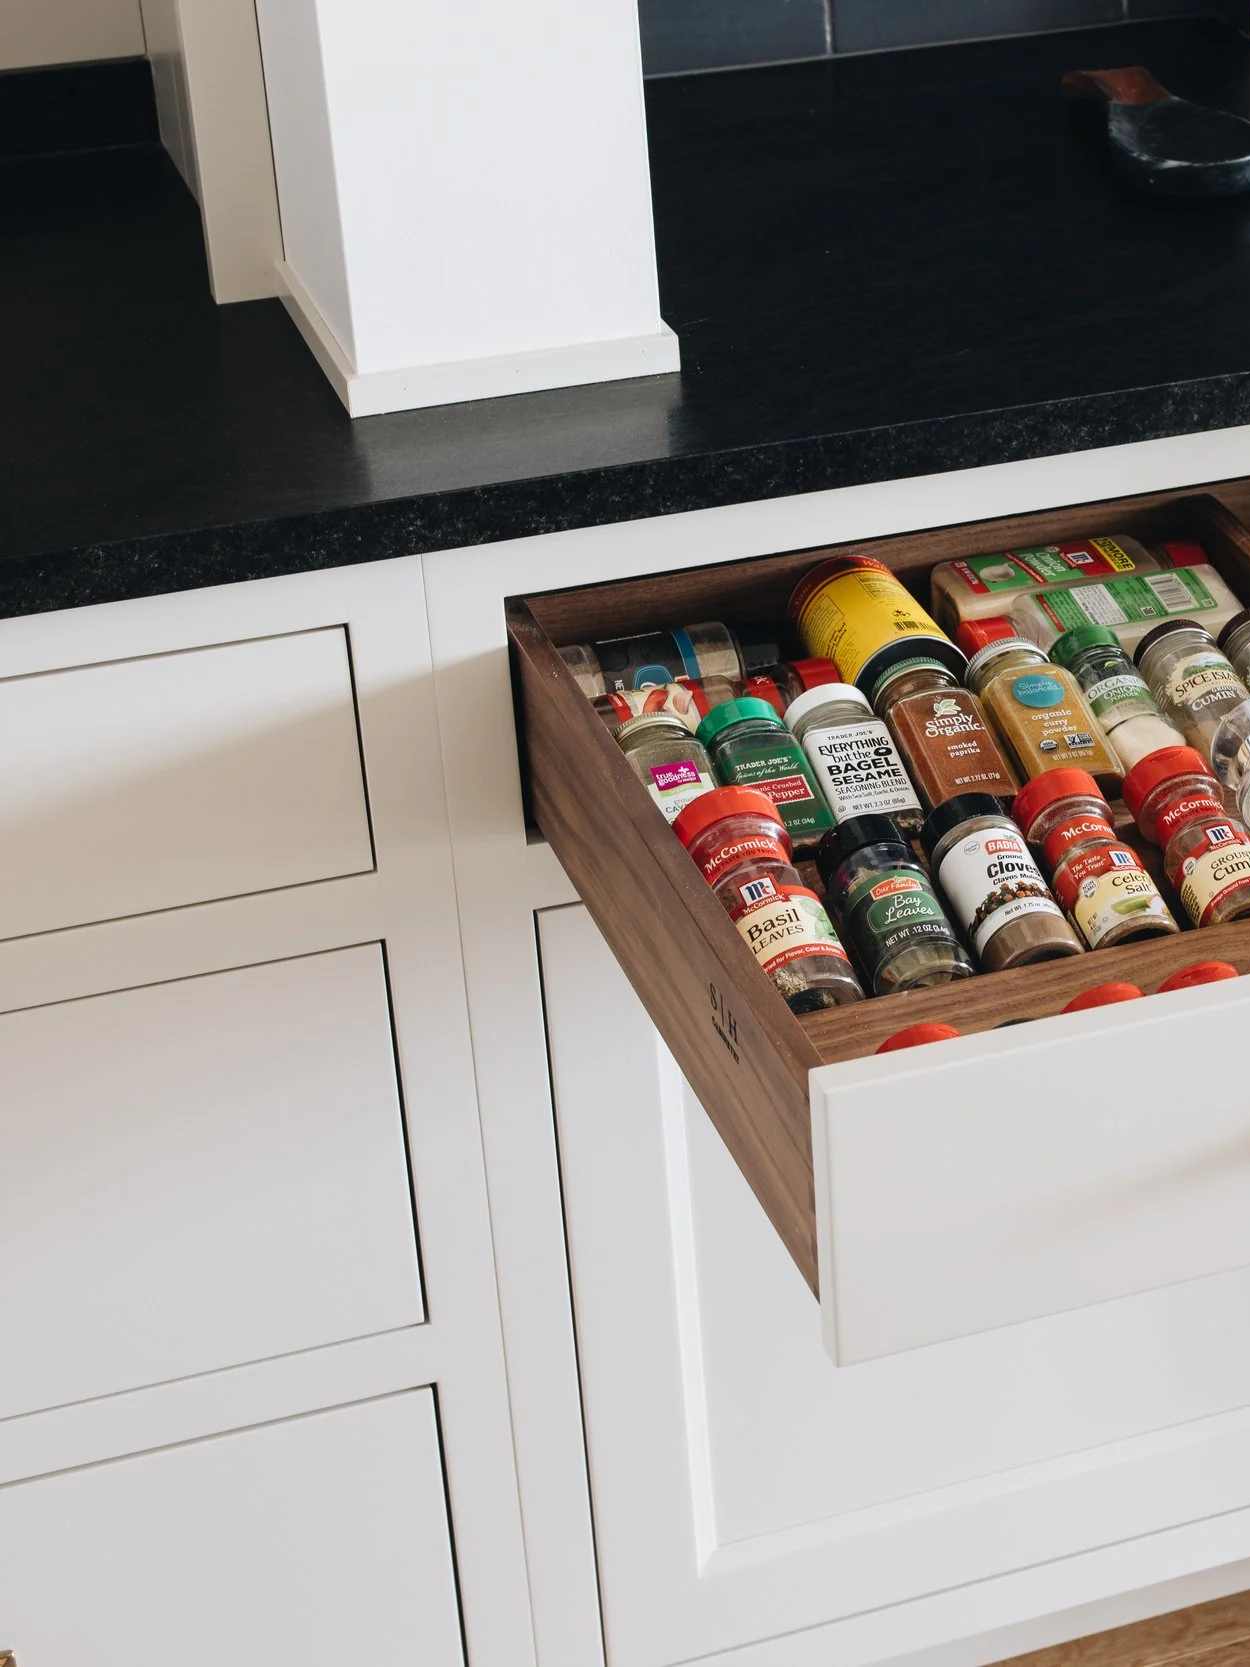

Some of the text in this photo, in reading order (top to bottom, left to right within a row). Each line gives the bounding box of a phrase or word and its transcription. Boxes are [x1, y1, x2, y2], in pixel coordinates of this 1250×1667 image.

[1019, 553, 1057, 577] Powder
[1036, 551, 1066, 572] Onion
[1019, 679, 1054, 690] Simply
[1087, 675, 1146, 699] ORGANIC
[1103, 685, 1140, 699] ONION
[1175, 674, 1211, 698] SPICE
[1191, 690, 1236, 711] CUMIN
[1031, 708, 1073, 720] organic
[925, 713, 973, 731] Simply
[1044, 719, 1068, 728] curry
[854, 730, 873, 738] JOE'S
[1042, 725, 1077, 736] powder
[818, 736, 889, 756] EVERYTHING
[947, 740, 977, 751] smoked
[949, 747, 980, 758] paprika
[735, 756, 789, 771] TRADER JOE'S
[832, 750, 872, 763] but the
[778, 762, 800, 772] World
[827, 756, 898, 776] BAGEL
[655, 772, 673, 780] true
[657, 771, 696, 787] goodness
[831, 768, 903, 787] SESAME
[772, 780, 802, 790] Crushed
[835, 778, 907, 796] SEASONING BLEND
[767, 787, 805, 800] Pepper
[988, 840, 1020, 851] BADIA
[704, 838, 778, 874] McCormick
[721, 855, 742, 868] TASTE
[986, 861, 1041, 879] Cloves
[1071, 855, 1101, 873] The Taste
[993, 873, 1018, 886] Clavos
[1074, 870, 1086, 880] You
[1112, 872, 1152, 887] Celery
[875, 881, 918, 895] Our Family
[1082, 880, 1095, 890] NON
[1125, 883, 1152, 895] Salt
[742, 893, 785, 915] McCormick
[892, 894, 922, 909] Bay
[884, 906, 935, 925] Leaves
[1004, 907, 1014, 916] Net
[746, 908, 801, 943] Basil
[752, 924, 805, 955] LEAVES
[885, 934, 899, 948] NET
[899, 929, 910, 939] WT
[912, 926, 922, 934] .12
[924, 924, 933, 932] OZ
[764, 962, 776, 972] ried
[776, 956, 785, 964] for
[785, 949, 805, 959] Flavor,
